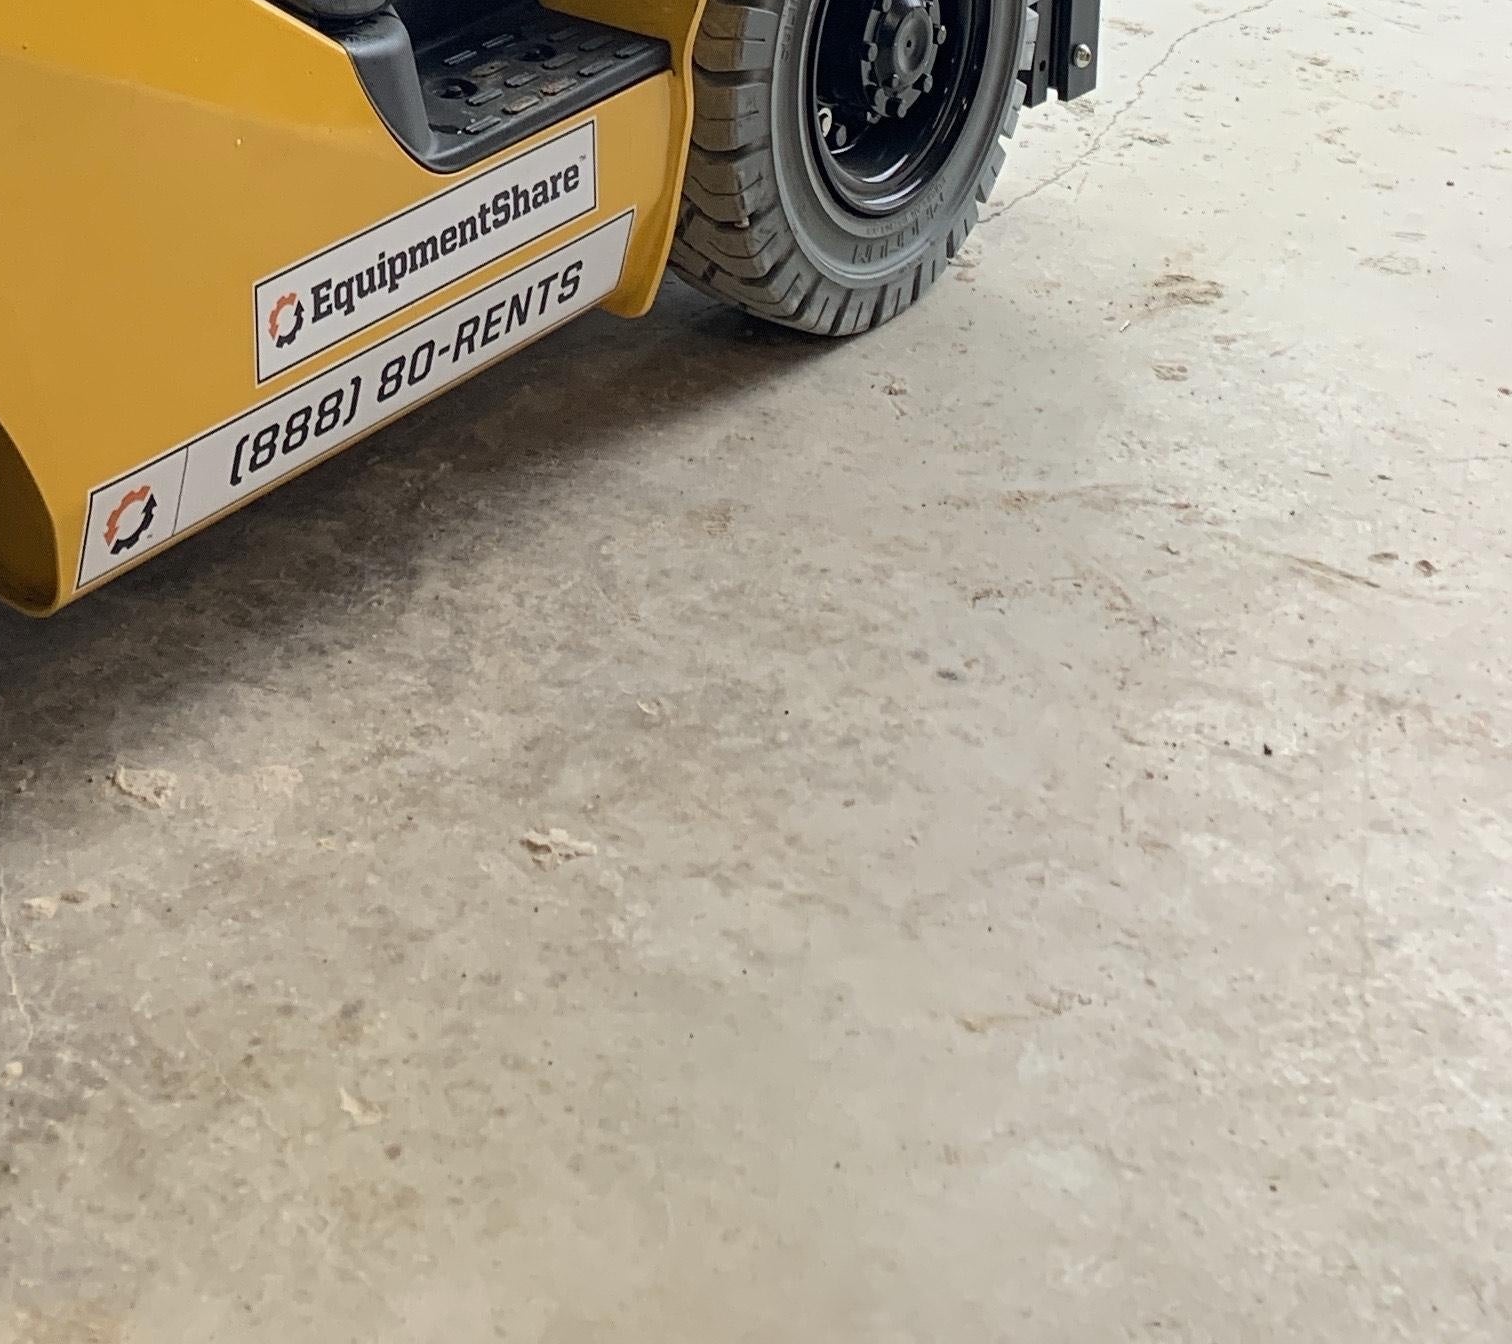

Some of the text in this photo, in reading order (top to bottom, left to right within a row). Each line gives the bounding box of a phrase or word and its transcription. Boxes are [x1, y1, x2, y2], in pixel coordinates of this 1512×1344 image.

[311, 162, 580, 325] EquipmentShare
[229, 259, 585, 487] (888) 80-RENTS
